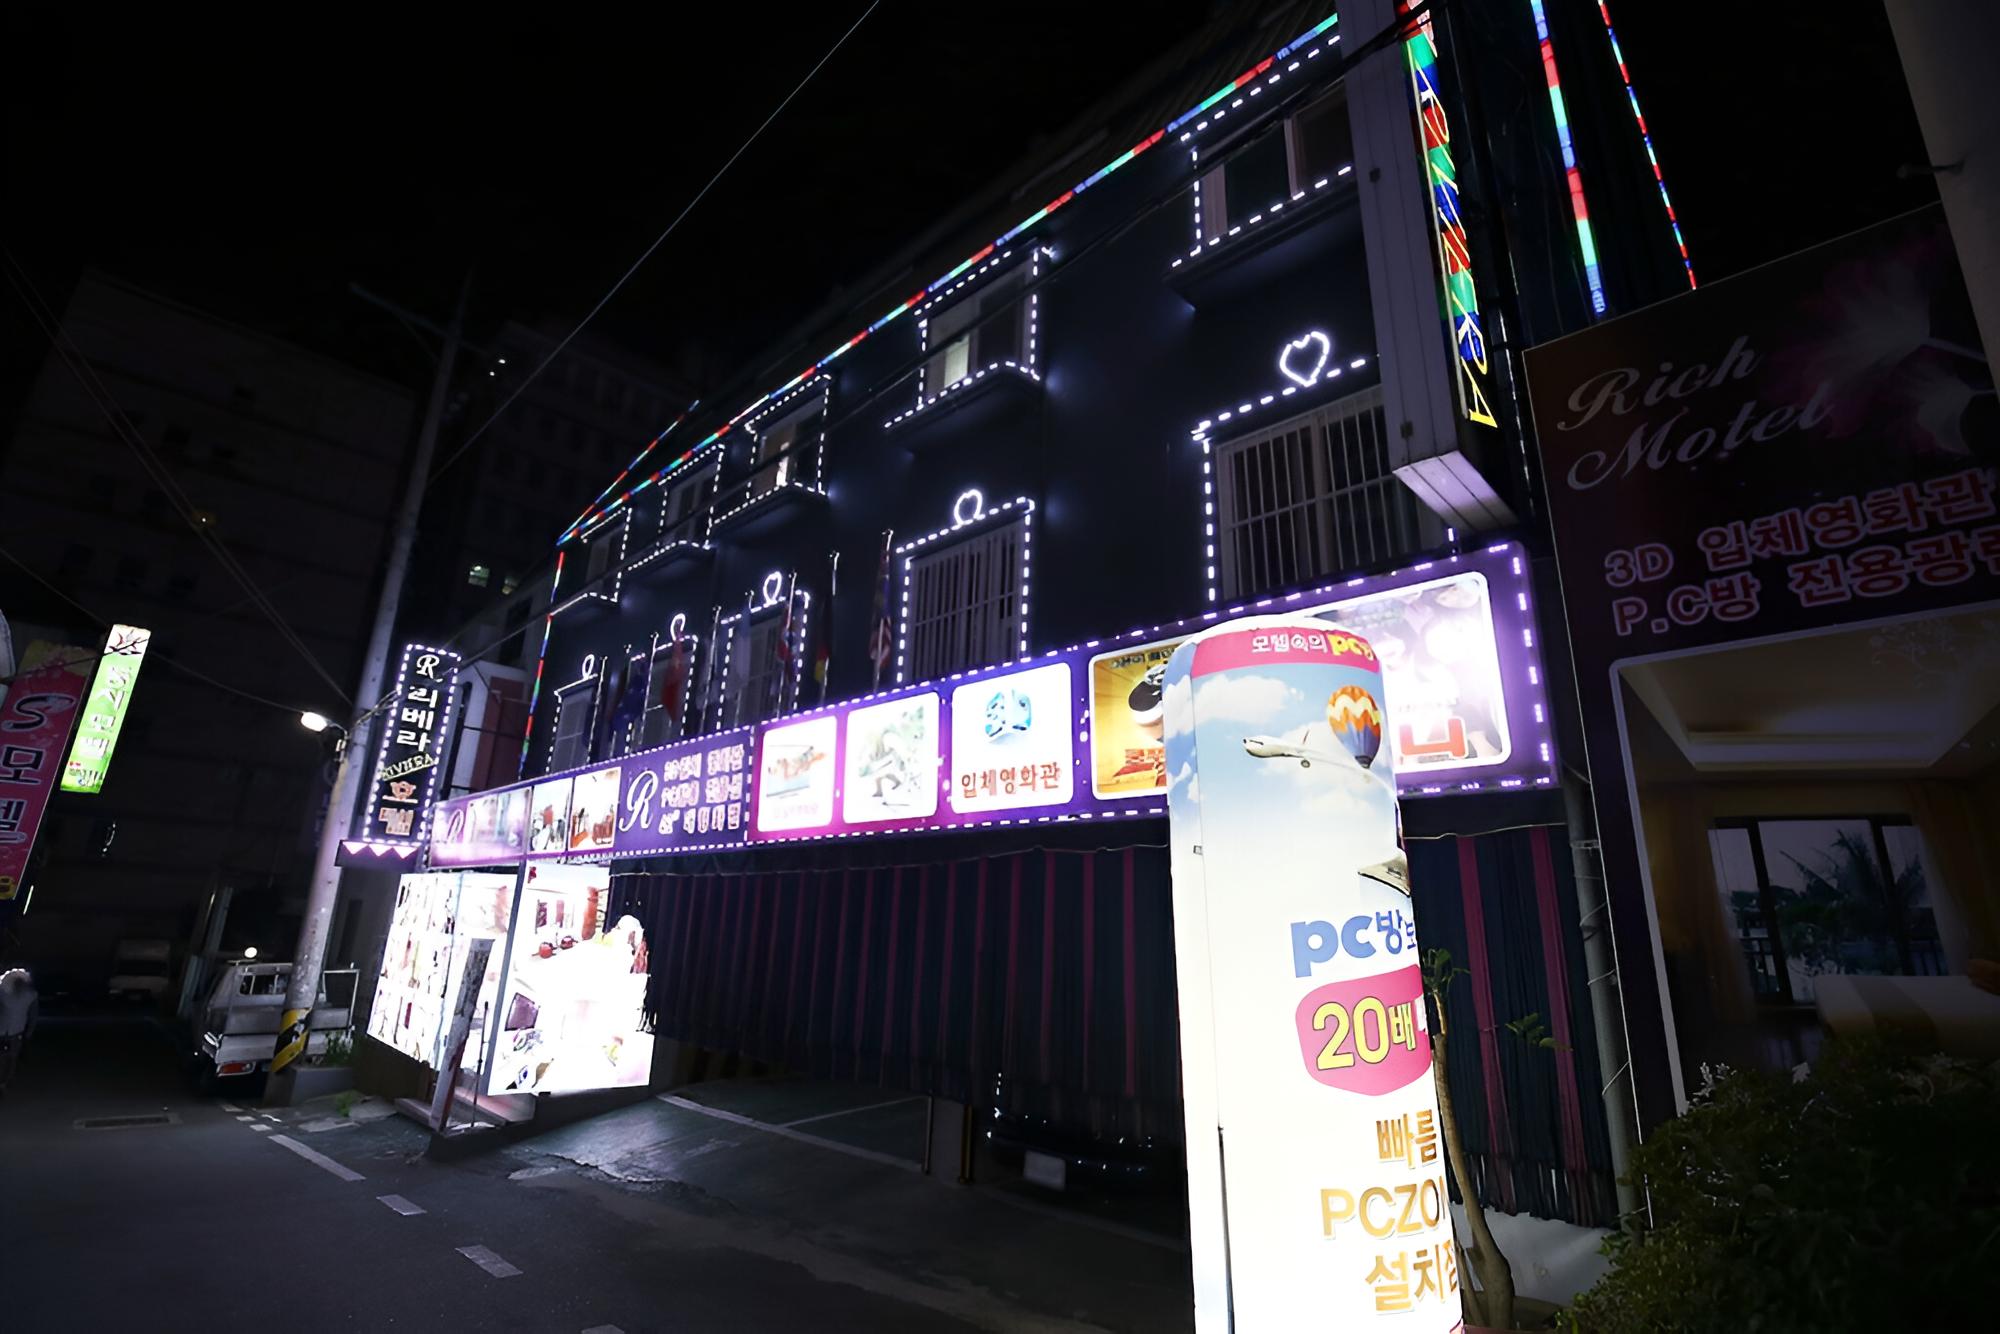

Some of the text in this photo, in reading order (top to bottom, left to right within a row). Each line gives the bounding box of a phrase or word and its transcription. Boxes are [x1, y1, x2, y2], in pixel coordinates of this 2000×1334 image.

[1557, 335, 1762, 431] Rich
[1566, 382, 1834, 491] Motel
[1605, 468, 1990, 586] 3D 입체영화관
[1611, 573, 1760, 636] P.C방
[417, 654, 443, 682] R
[396, 686, 438, 752] 리베라
[961, 762, 1060, 798] 입체영화관
[1376, 1110, 1438, 1169] 빠름
